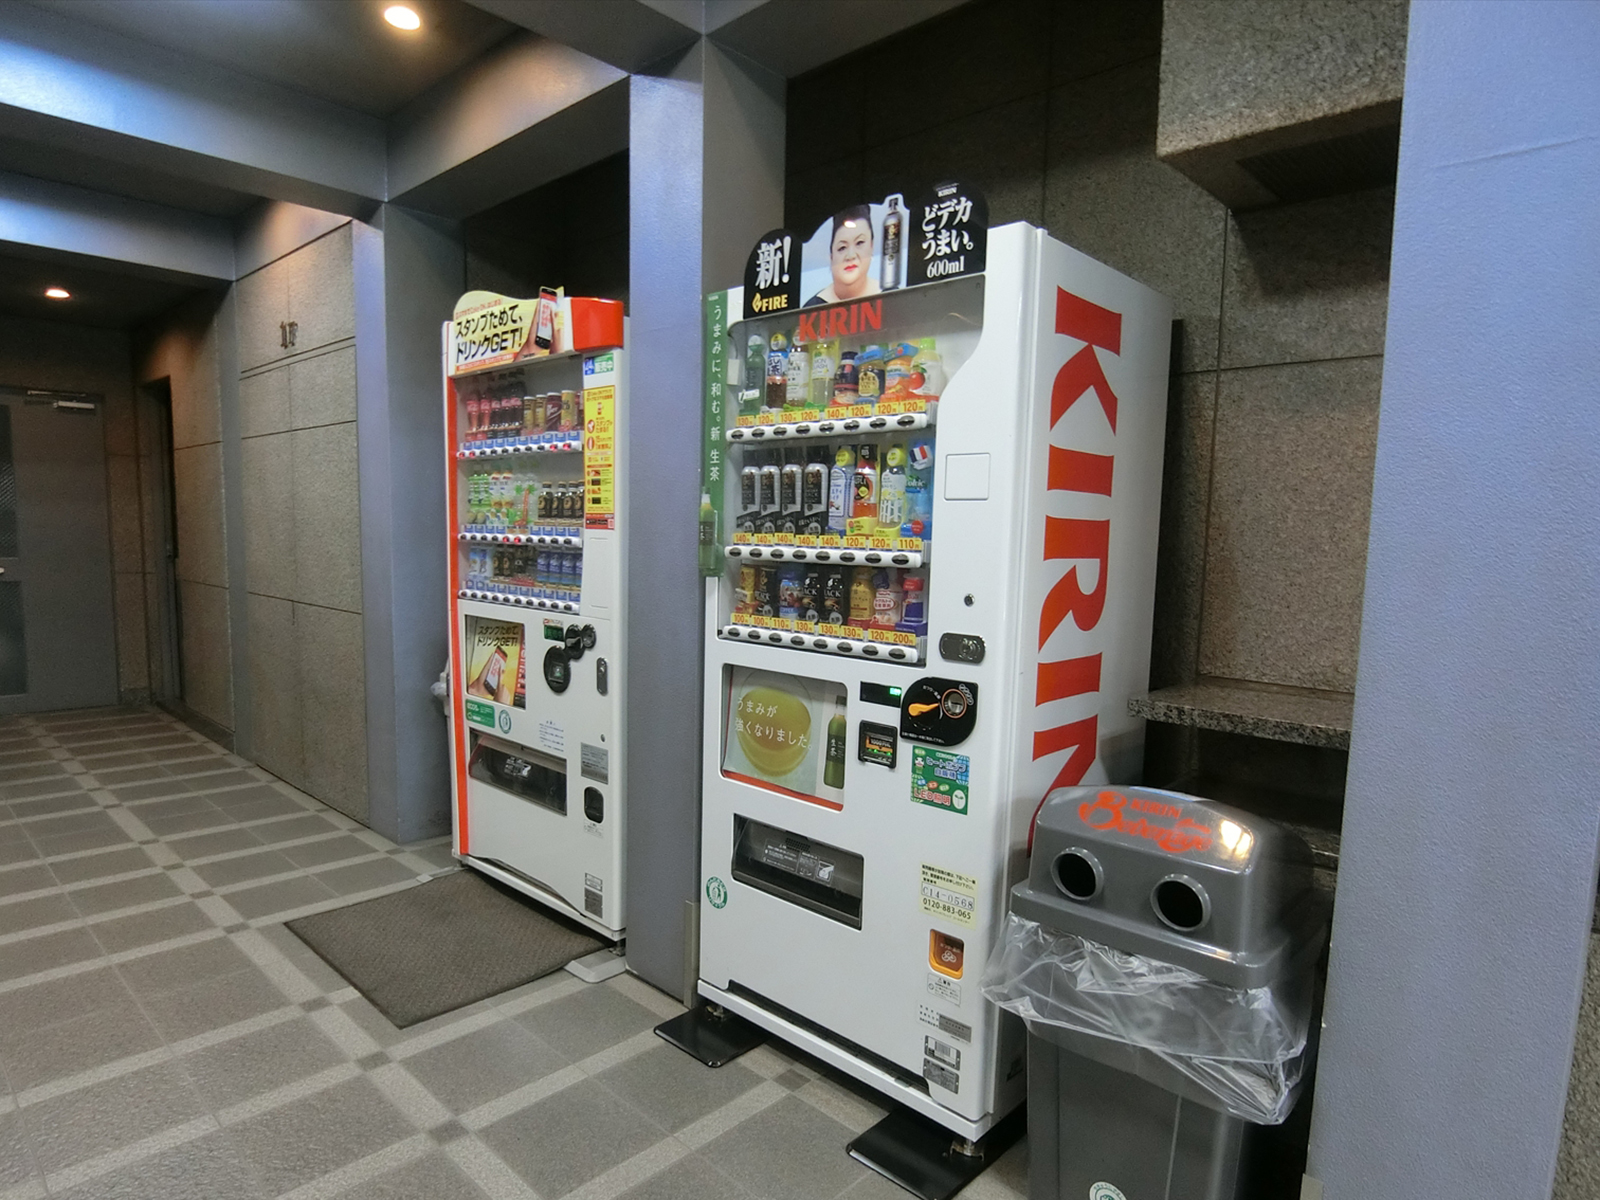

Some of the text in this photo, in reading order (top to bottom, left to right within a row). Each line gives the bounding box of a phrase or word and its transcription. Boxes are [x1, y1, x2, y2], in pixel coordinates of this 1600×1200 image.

[922, 197, 973, 231] どデカ
[922, 229, 974, 260] うまい。
[927, 255, 965, 278] 600ml
[762, 294, 788, 312] FIRE
[799, 299, 883, 342] KIRIN
[737, 696, 777, 718] うまみが
[735, 717, 813, 750] 強くなりました。
[1130, 798, 1183, 819] KIRIN
[922, 898, 972, 920] 0120-883-065
